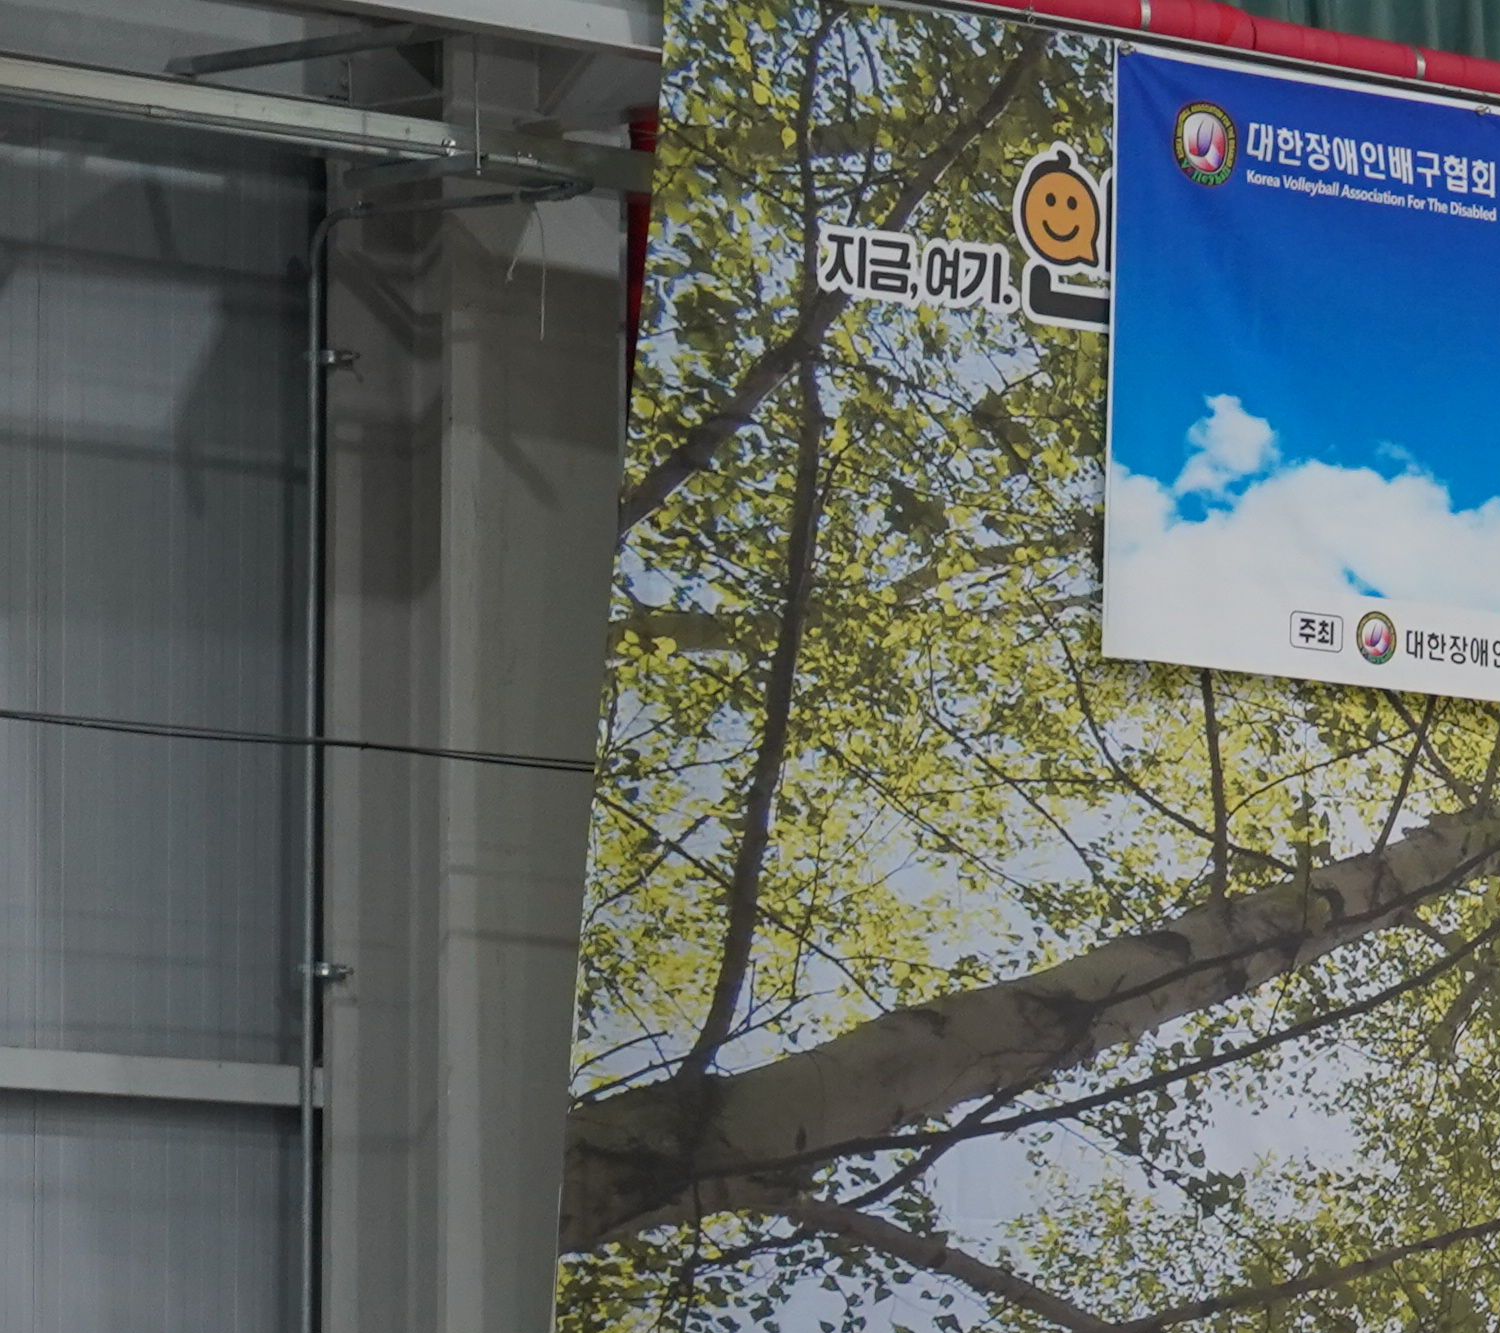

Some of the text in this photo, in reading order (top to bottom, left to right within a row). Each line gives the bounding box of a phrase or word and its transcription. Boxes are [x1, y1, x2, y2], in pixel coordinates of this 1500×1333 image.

[1246, 121, 1497, 198] 대한장애인배구협회
[1246, 169, 1497, 222] Korea Volleyball Association For The Disabled
[926, 244, 1014, 305] 여기.
[1298, 617, 1336, 647] 주최
